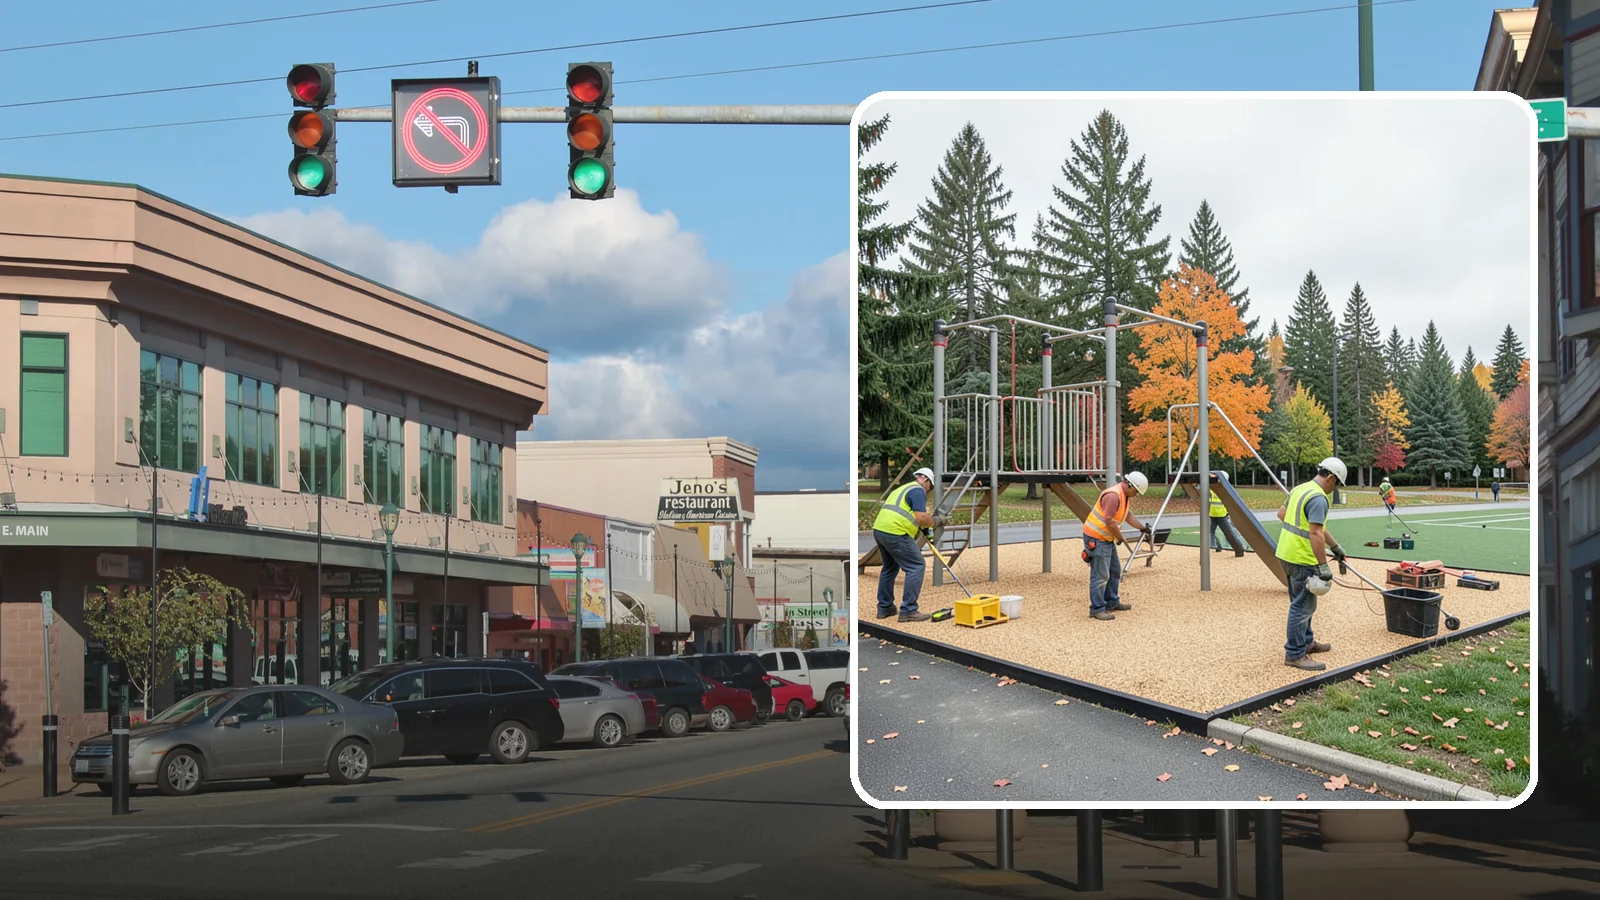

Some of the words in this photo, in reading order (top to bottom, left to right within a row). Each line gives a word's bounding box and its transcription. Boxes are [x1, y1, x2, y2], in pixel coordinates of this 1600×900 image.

[670, 480, 727, 494] Jeno's
[665, 496, 731, 509] restaurant
[659, 510, 681, 520] Italian
[686, 509, 714, 519] American
[715, 509, 737, 519] Cuisine
[2, 525, 13, 536] E.
[15, 525, 49, 536] MAIN
[797, 607, 829, 617] Street
[790, 619, 824, 627] lass
